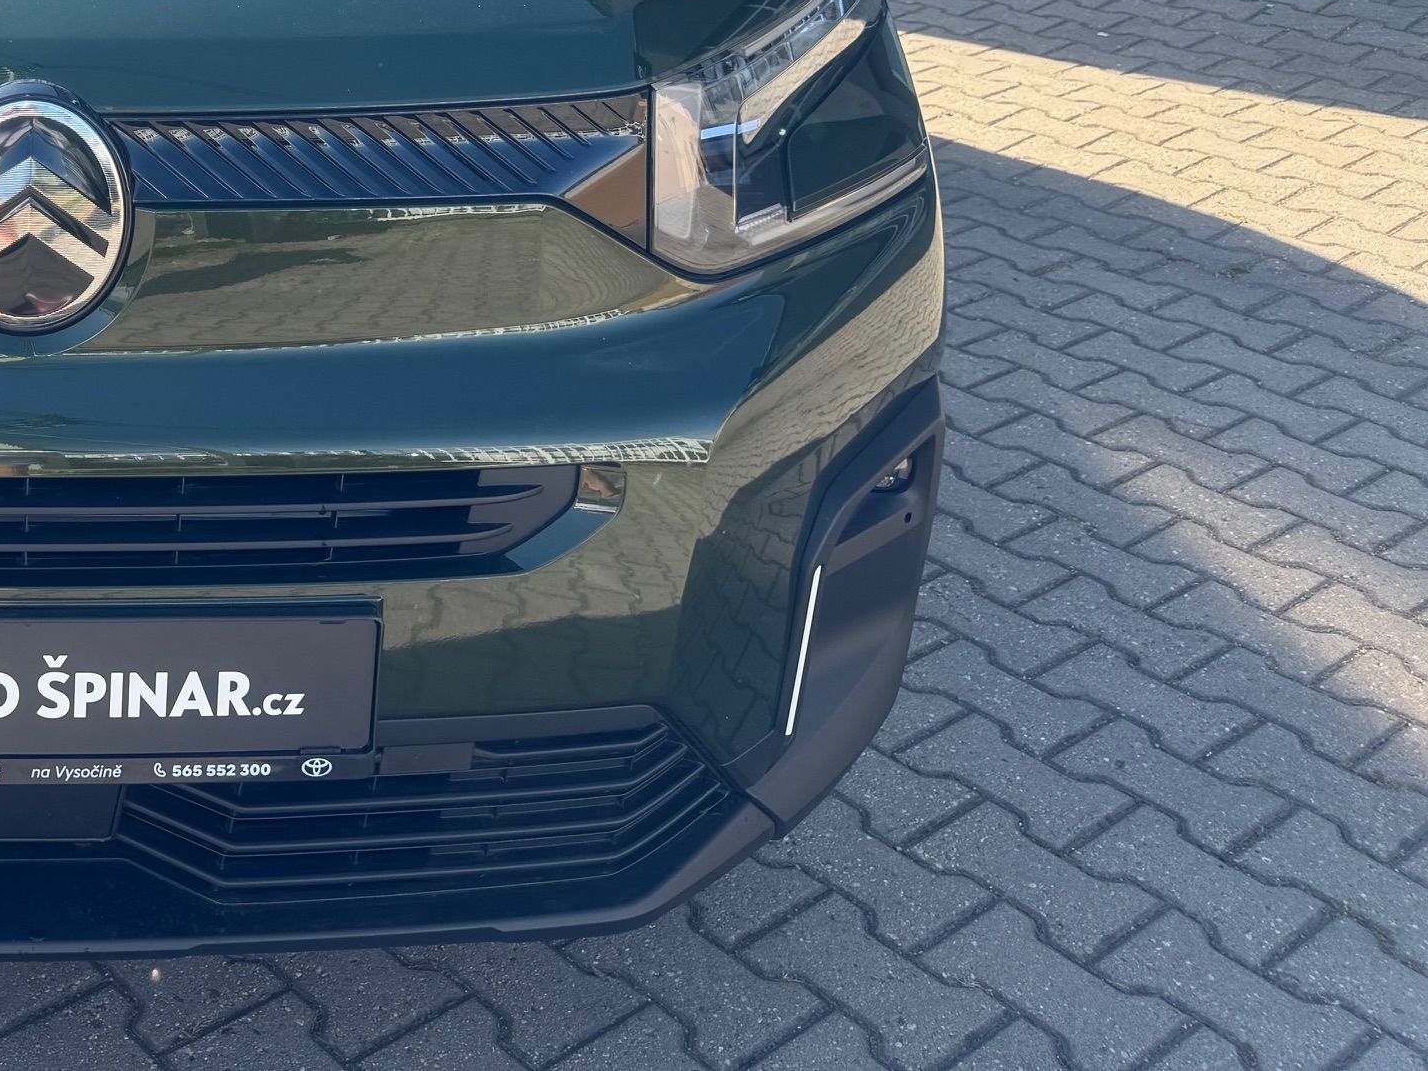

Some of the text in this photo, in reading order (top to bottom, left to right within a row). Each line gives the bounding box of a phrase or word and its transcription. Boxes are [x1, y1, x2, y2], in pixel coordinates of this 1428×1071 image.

[36, 654, 305, 719] ŠPINAR.cz
[31, 767, 50, 779] na
[55, 764, 123, 782] Vysočině
[172, 764, 203, 777] 565
[206, 764, 236, 777] 552
[240, 763, 271, 776] 300
